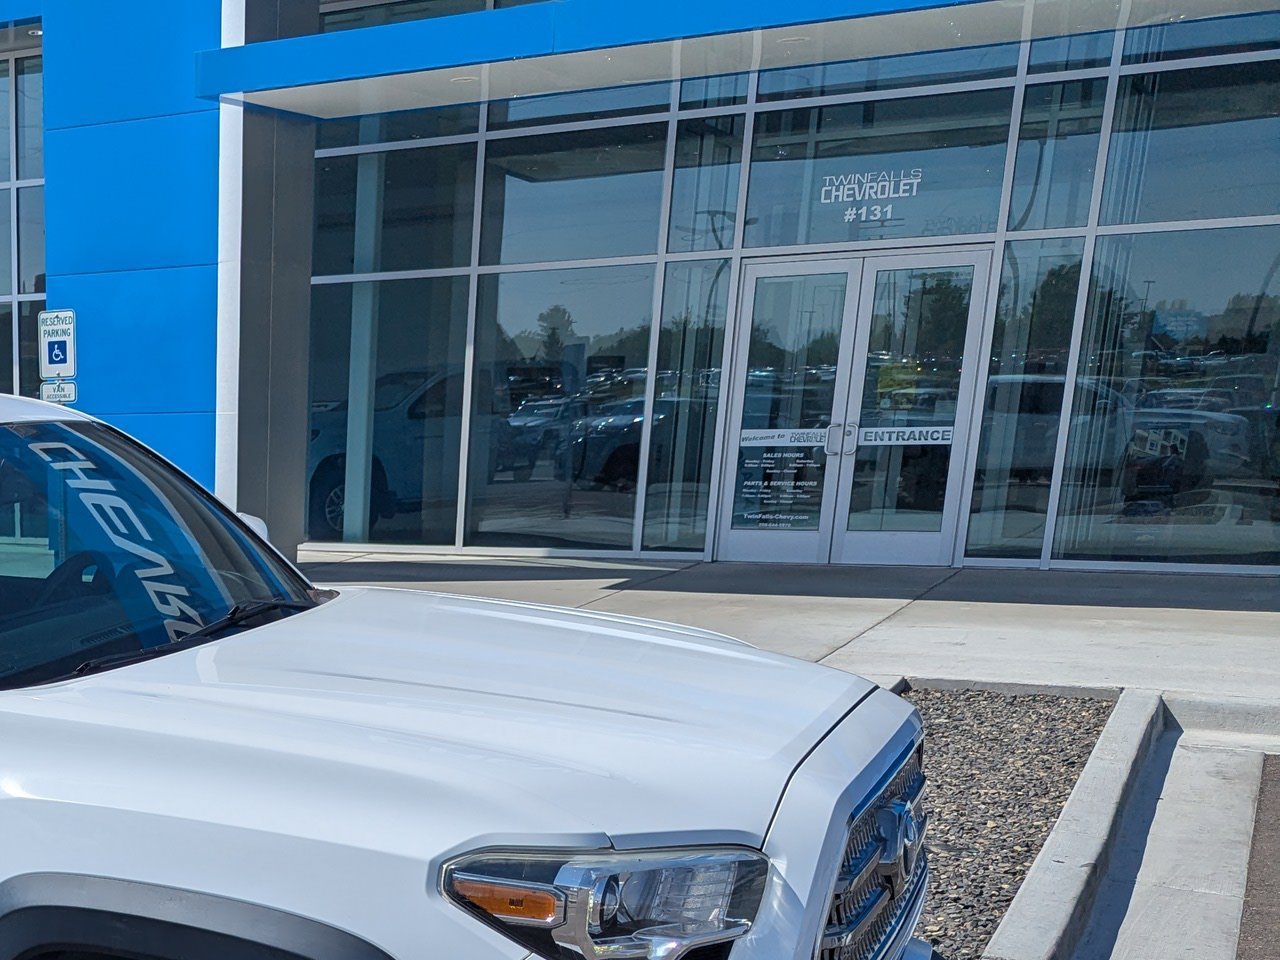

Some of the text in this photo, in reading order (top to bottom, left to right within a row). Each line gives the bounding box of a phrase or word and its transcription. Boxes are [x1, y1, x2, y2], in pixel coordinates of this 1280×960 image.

[822, 168, 923, 186] TWINFALLS
[820, 178, 922, 204] CHEVROLET
[843, 204, 893, 223] #131
[41, 315, 73, 327] RESERVED
[43, 328, 71, 338] PARKING
[741, 434, 776, 442] Welcome
[863, 429, 952, 442] ENTRANCE
